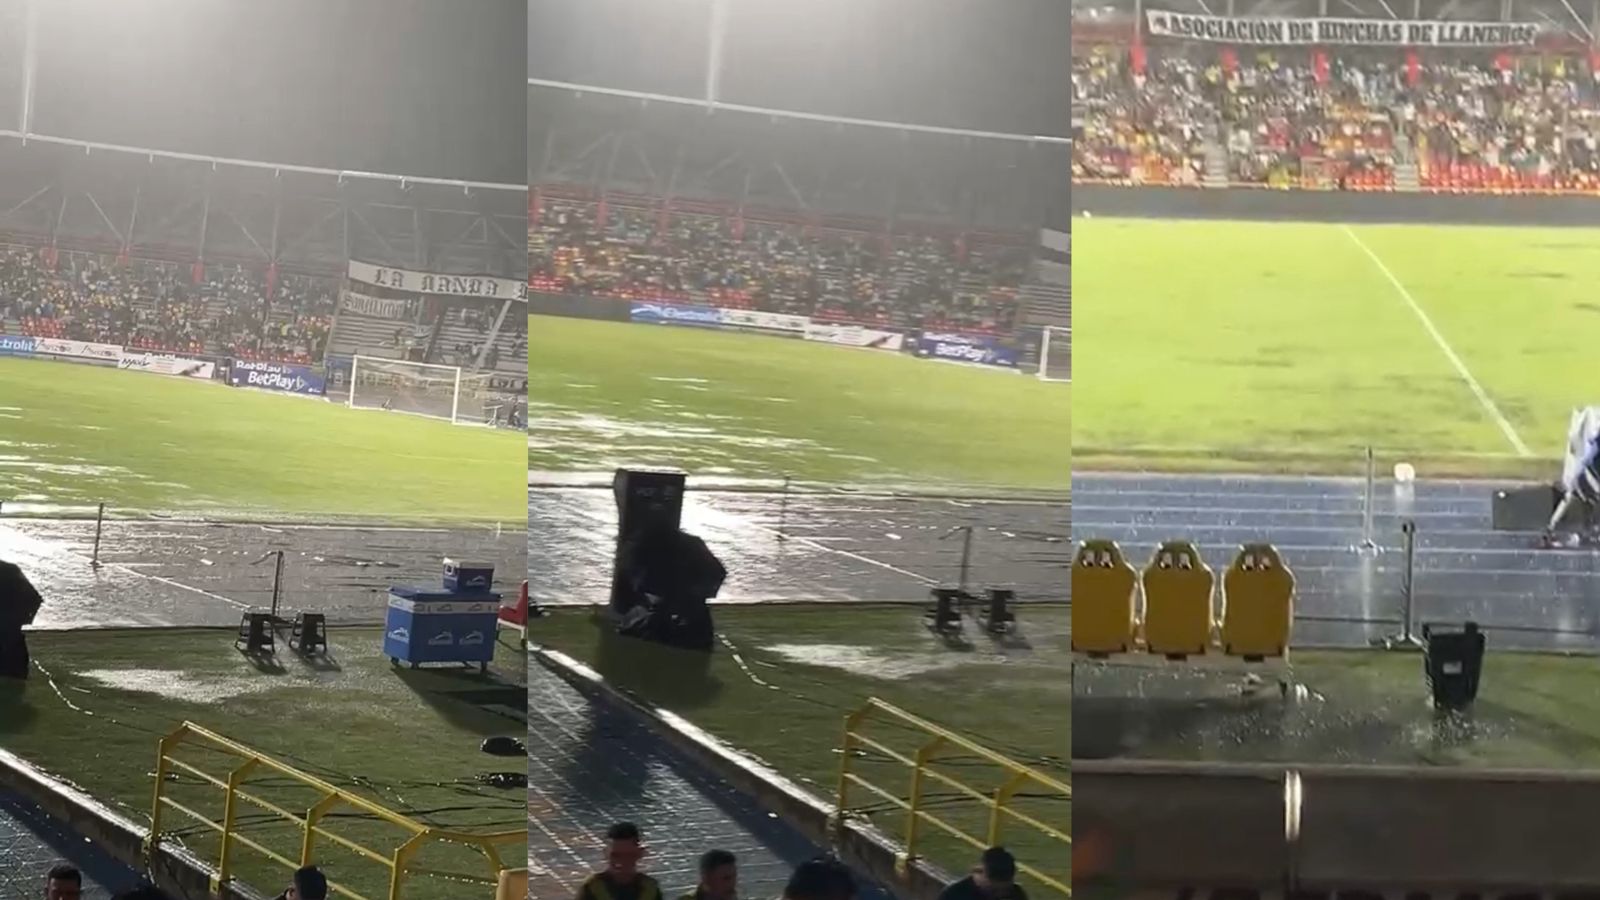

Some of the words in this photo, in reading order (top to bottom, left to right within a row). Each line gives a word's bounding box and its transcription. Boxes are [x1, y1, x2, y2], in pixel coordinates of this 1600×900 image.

[1288, 21, 1313, 41] DE
[1408, 23, 1433, 42] DE
[1438, 23, 1536, 42] LLANEROS
[374, 268, 404, 288] LA
[247, 371, 296, 390] BetPlay
